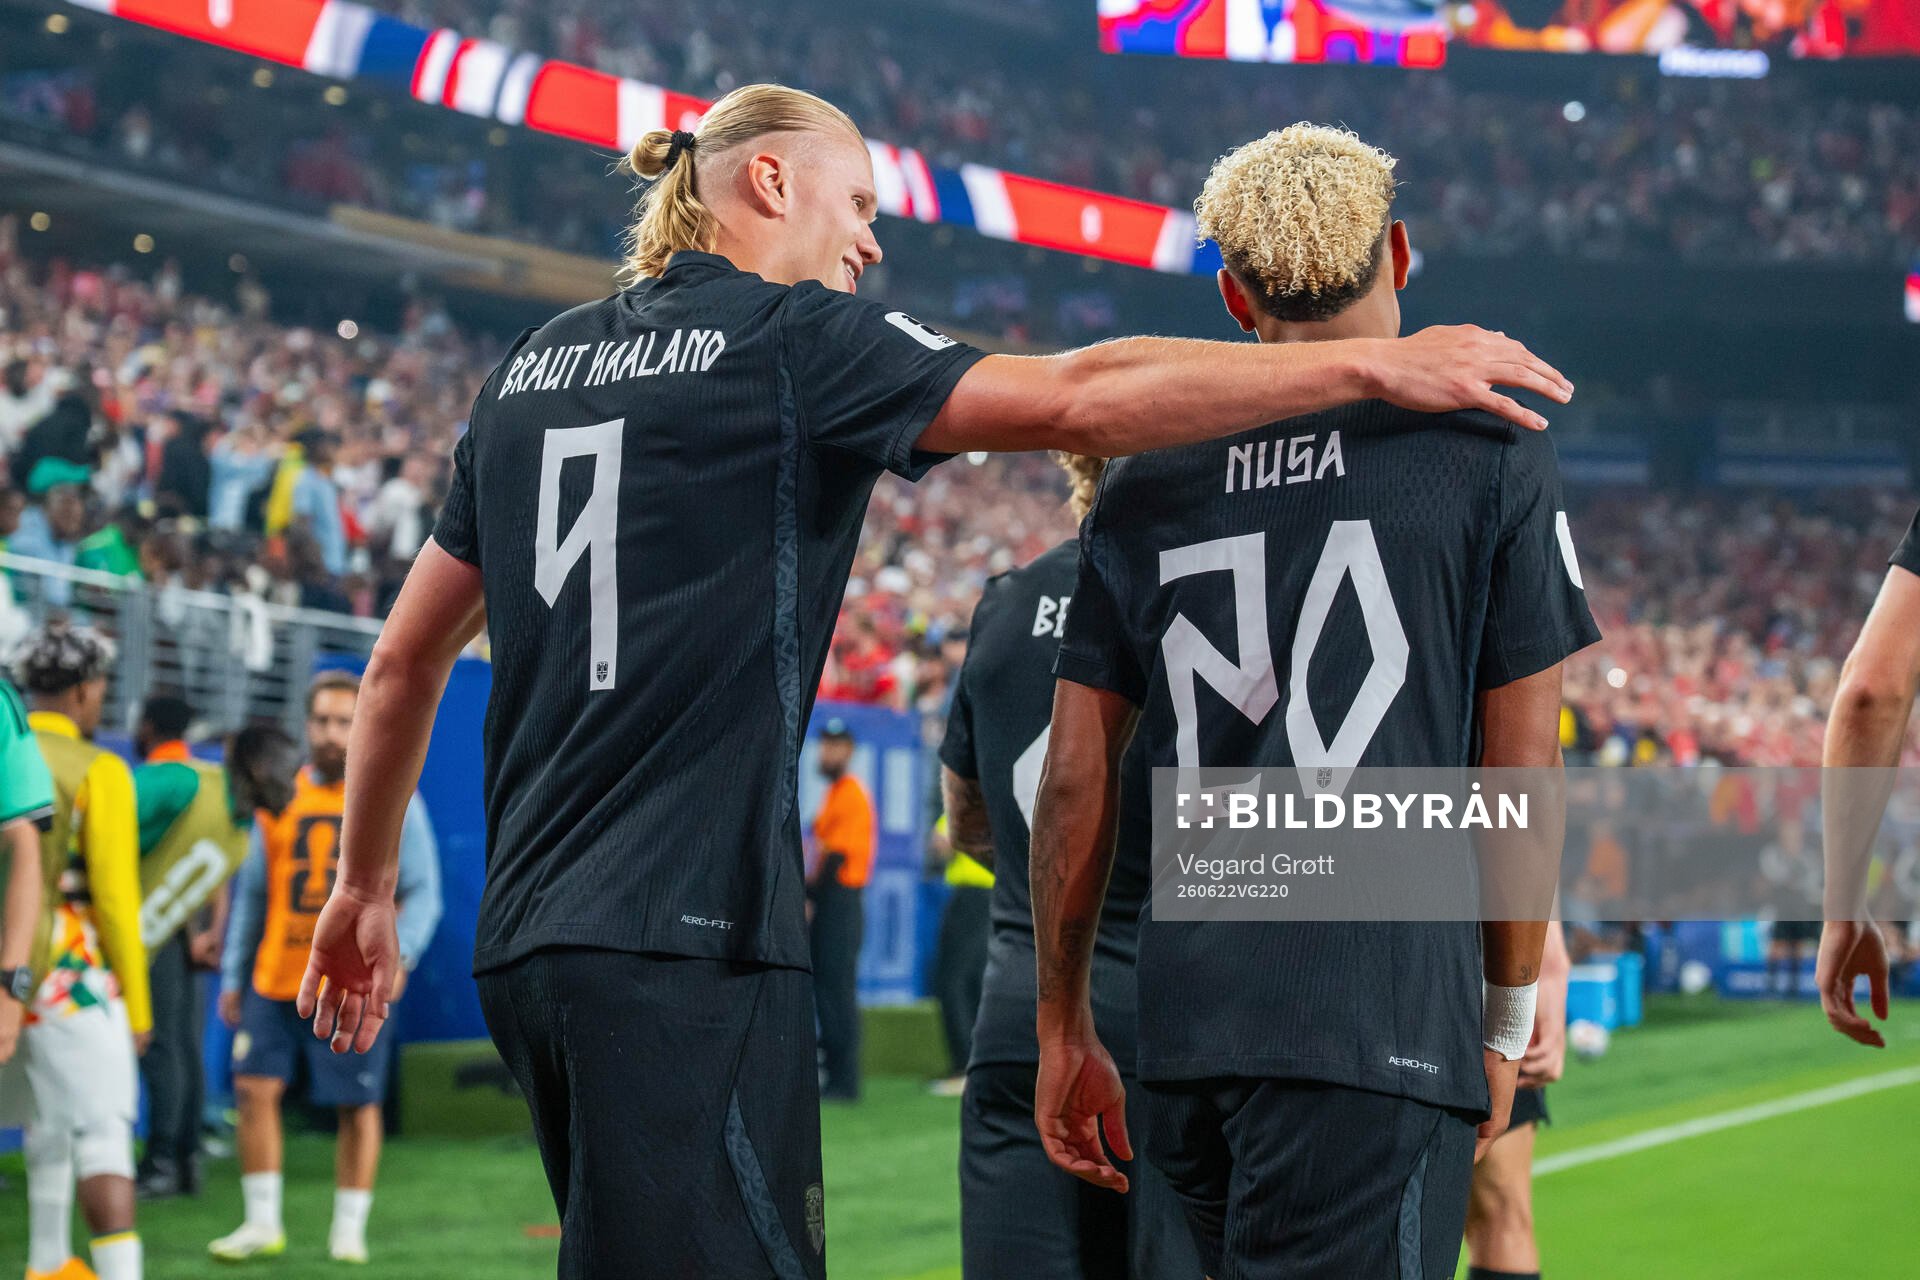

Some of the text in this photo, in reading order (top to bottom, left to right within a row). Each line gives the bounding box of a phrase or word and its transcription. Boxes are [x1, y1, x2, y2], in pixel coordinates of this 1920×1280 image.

[498, 343, 593, 400] BRAUT
[1224, 430, 1346, 494] NUSA
[535, 418, 625, 691] 9
[1159, 519, 1410, 825] 20
[680, 914, 734, 930] AERO-FIT
[1388, 1055, 1439, 1074] AERO-FIT
